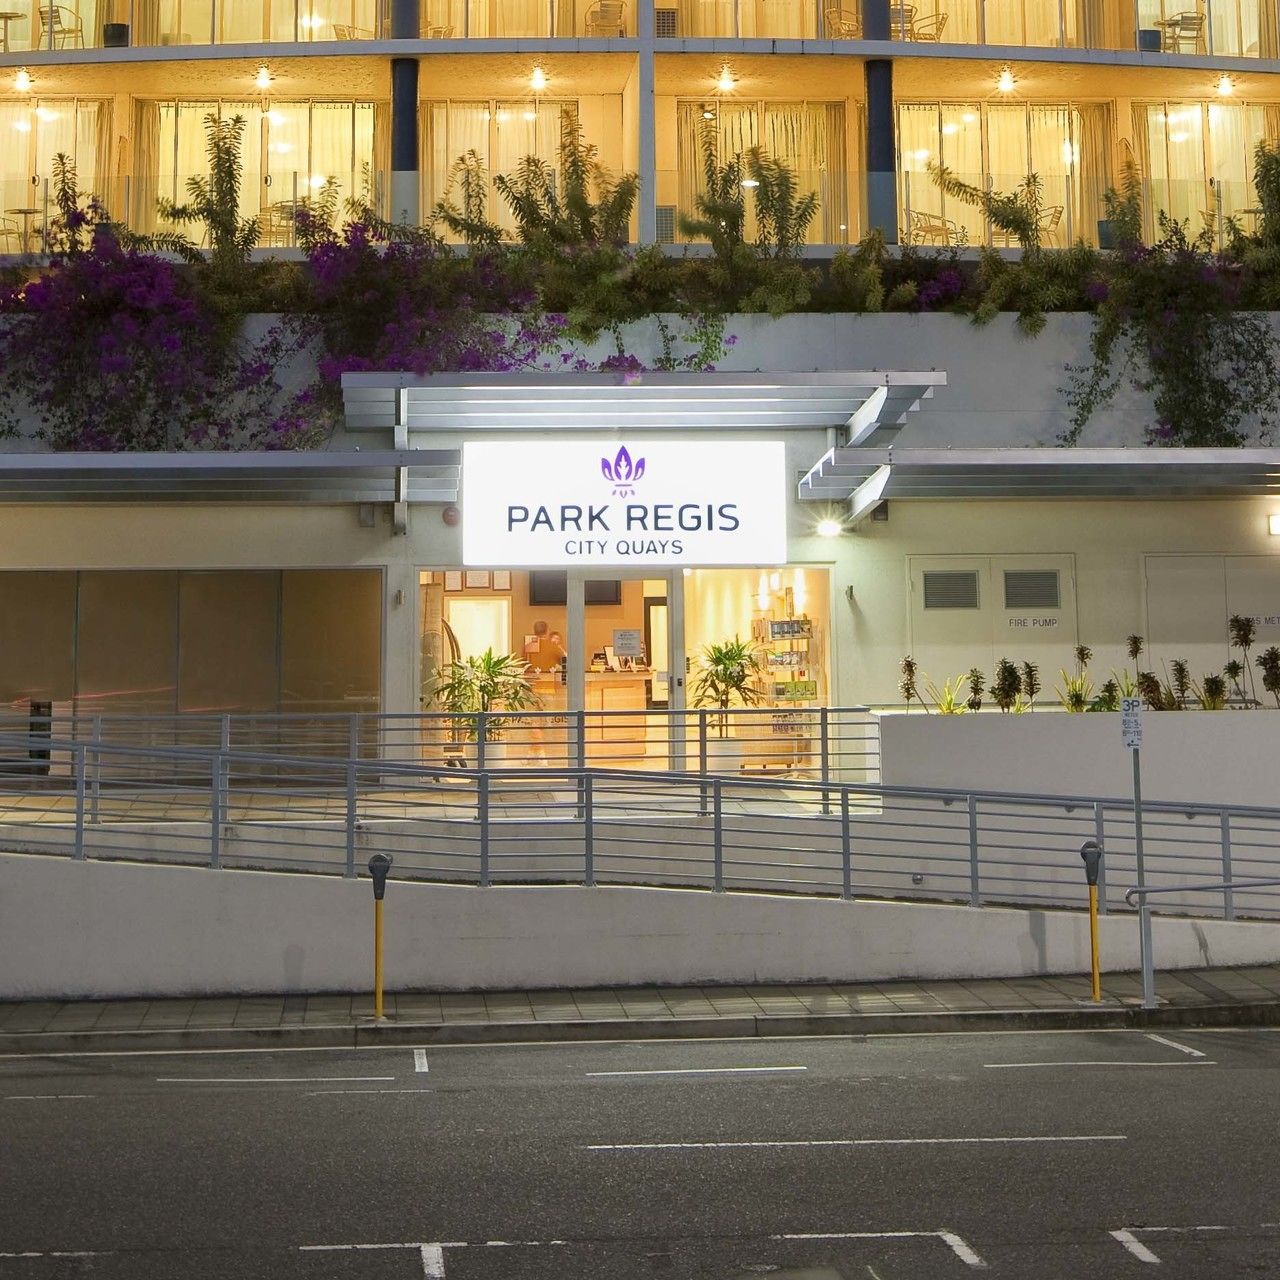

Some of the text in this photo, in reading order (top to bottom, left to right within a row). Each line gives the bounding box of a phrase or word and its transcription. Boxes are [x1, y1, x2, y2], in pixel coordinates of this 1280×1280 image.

[507, 503, 740, 532] PARK REGIS
[564, 539, 683, 556] CITY QUAYS
[1008, 618, 1057, 627] FIRE PUMP
[1122, 699, 1140, 711] 3P
